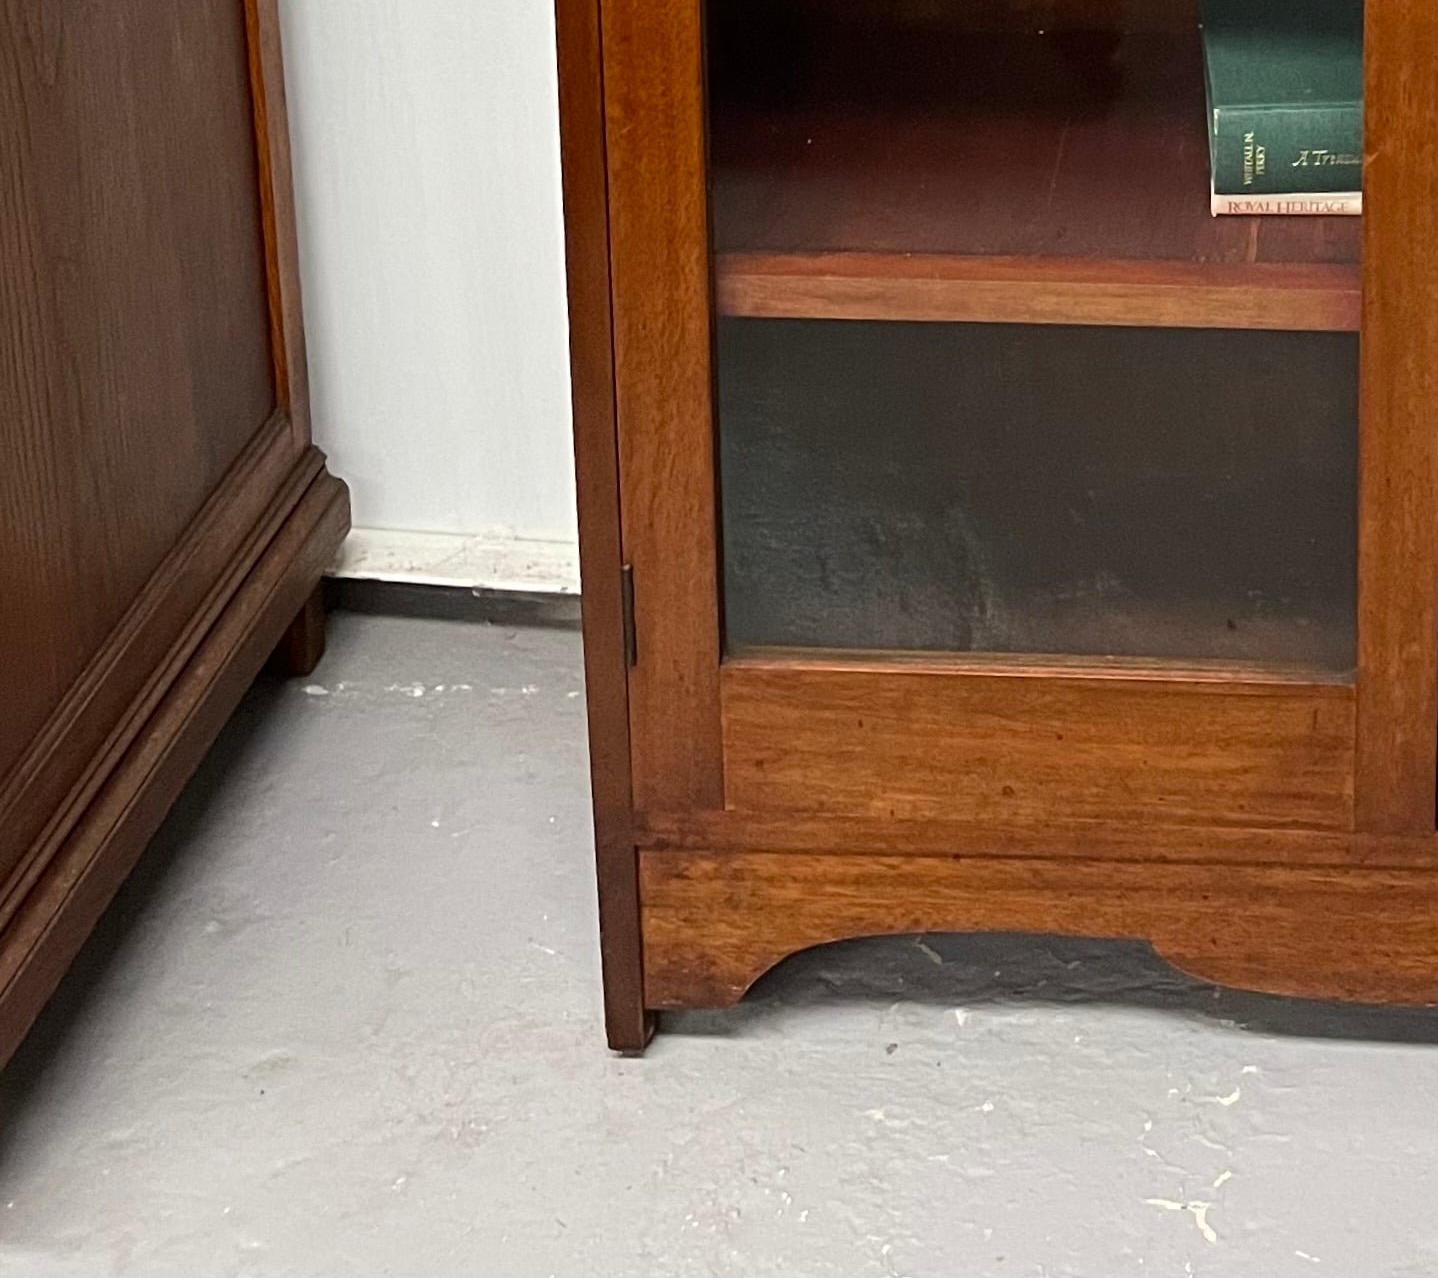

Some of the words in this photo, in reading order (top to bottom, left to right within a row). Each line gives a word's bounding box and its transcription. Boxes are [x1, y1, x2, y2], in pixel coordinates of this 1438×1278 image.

[1291, 150, 1310, 167] A
[1228, 201, 1274, 214] ROYAL
[1277, 201, 1349, 214] HERITAGE
